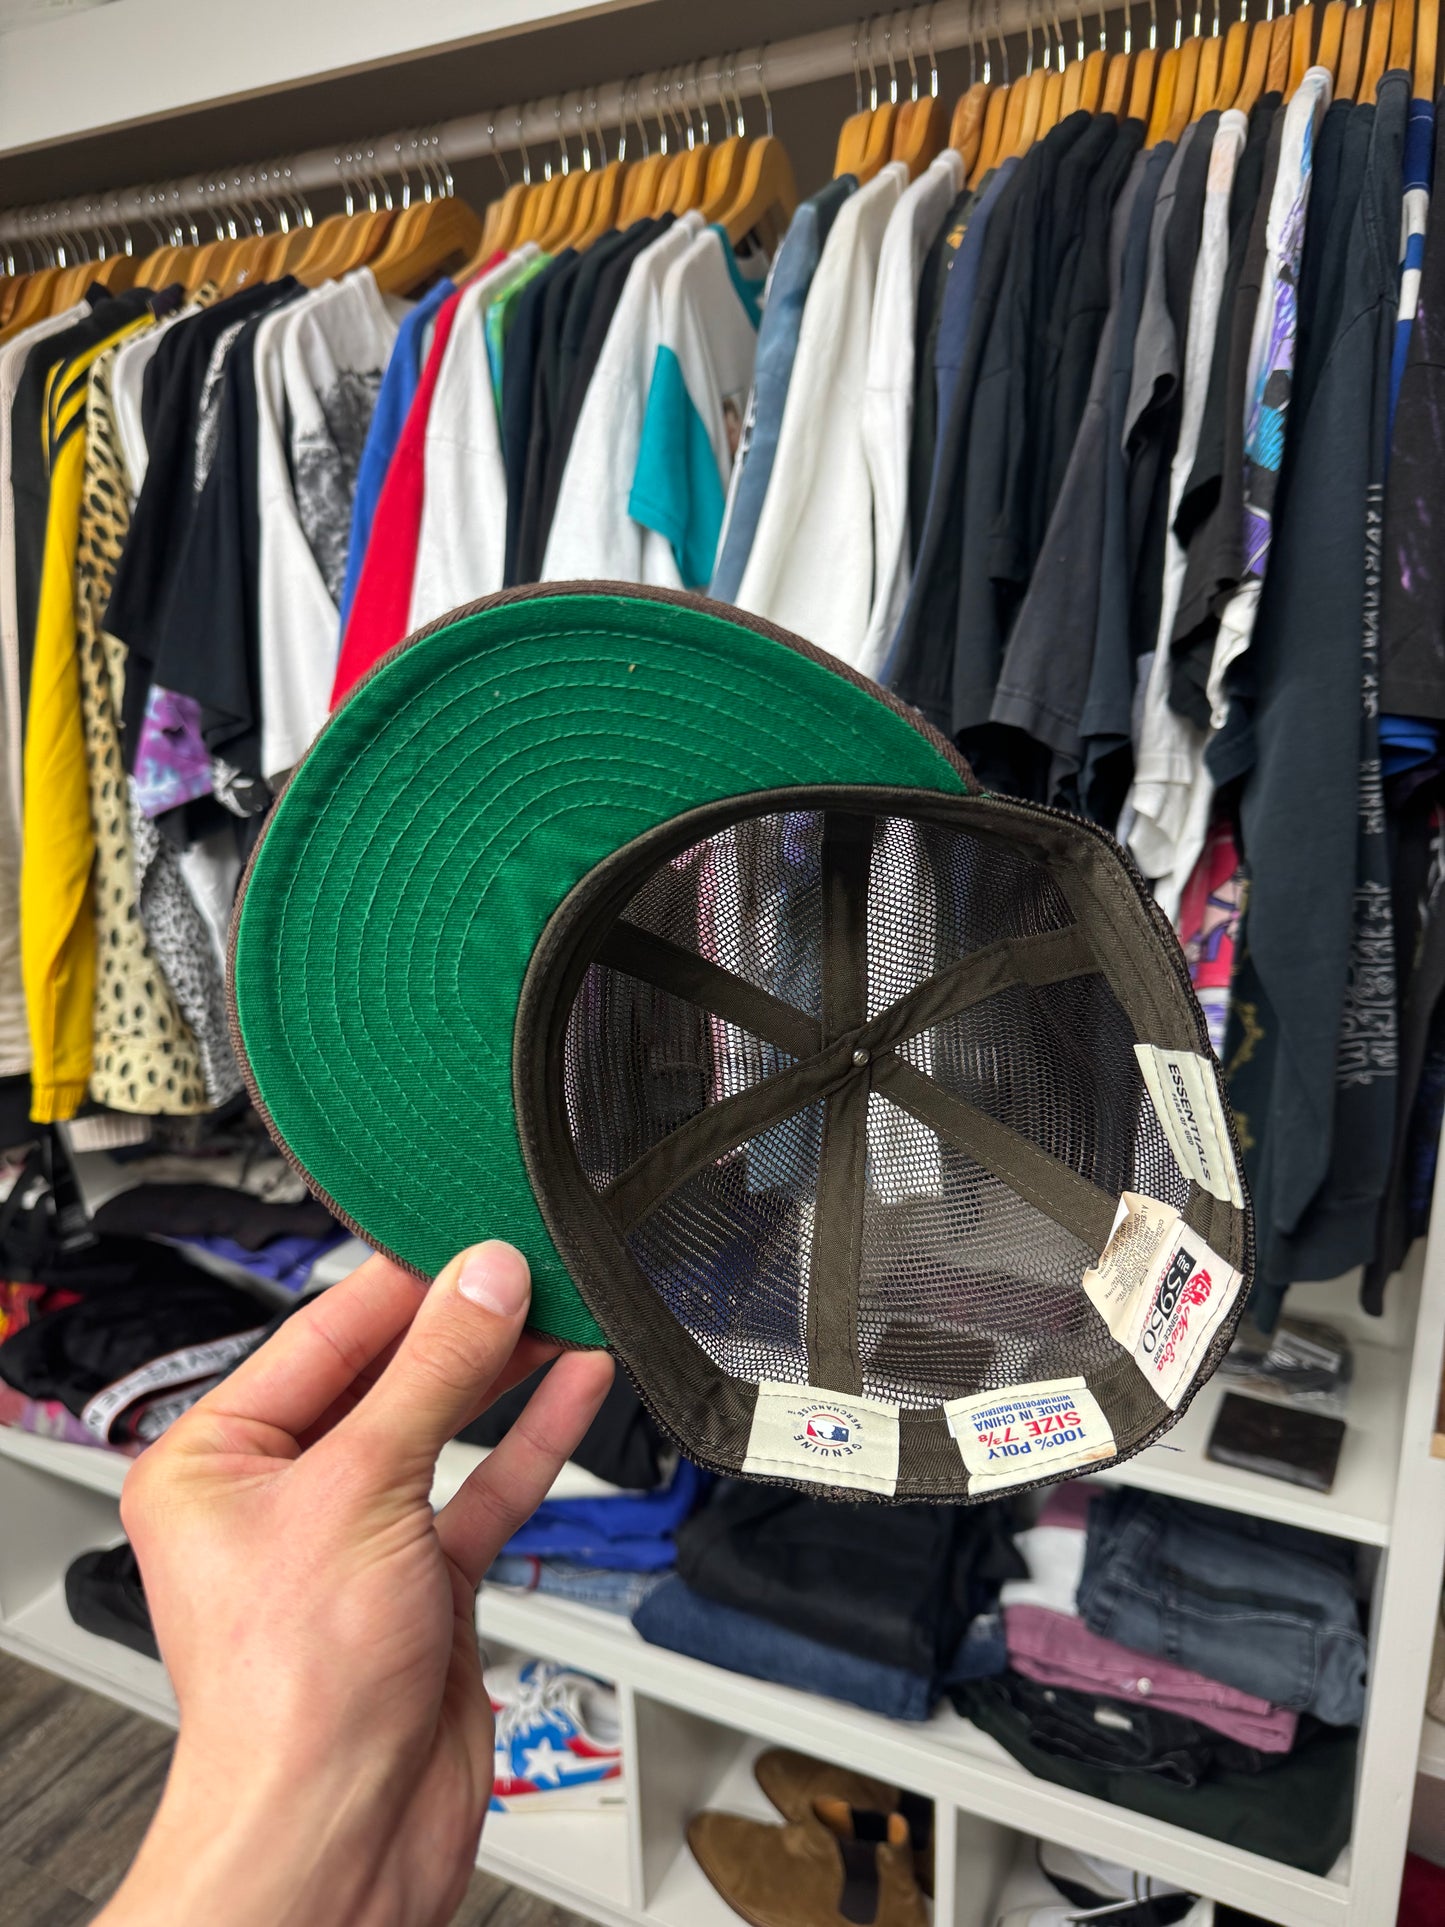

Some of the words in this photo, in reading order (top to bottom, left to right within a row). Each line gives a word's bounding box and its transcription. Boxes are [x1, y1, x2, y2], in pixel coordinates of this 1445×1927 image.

[1168, 1064, 1211, 1181] ESSENTIALS
[1176, 1254, 1190, 1273] the
[1161, 1312, 1179, 1342] SINCE
[1168, 1305, 1191, 1344] New
[1155, 1342, 1176, 1372] Era
[1011, 1397, 1051, 1410] IMPORTED
[1049, 1393, 1071, 1403] WITH
[970, 1403, 1012, 1420] MATERIALS
[1018, 1409, 1033, 1421] IN
[1035, 1400, 1075, 1417] MADE
[973, 1413, 1015, 1432] CHINA
[1024, 1411, 1081, 1437] SIZE
[792, 1433, 862, 1456] GENUINE
[1034, 1426, 1086, 1450] 100%
[988, 1440, 1032, 1460] POLY
